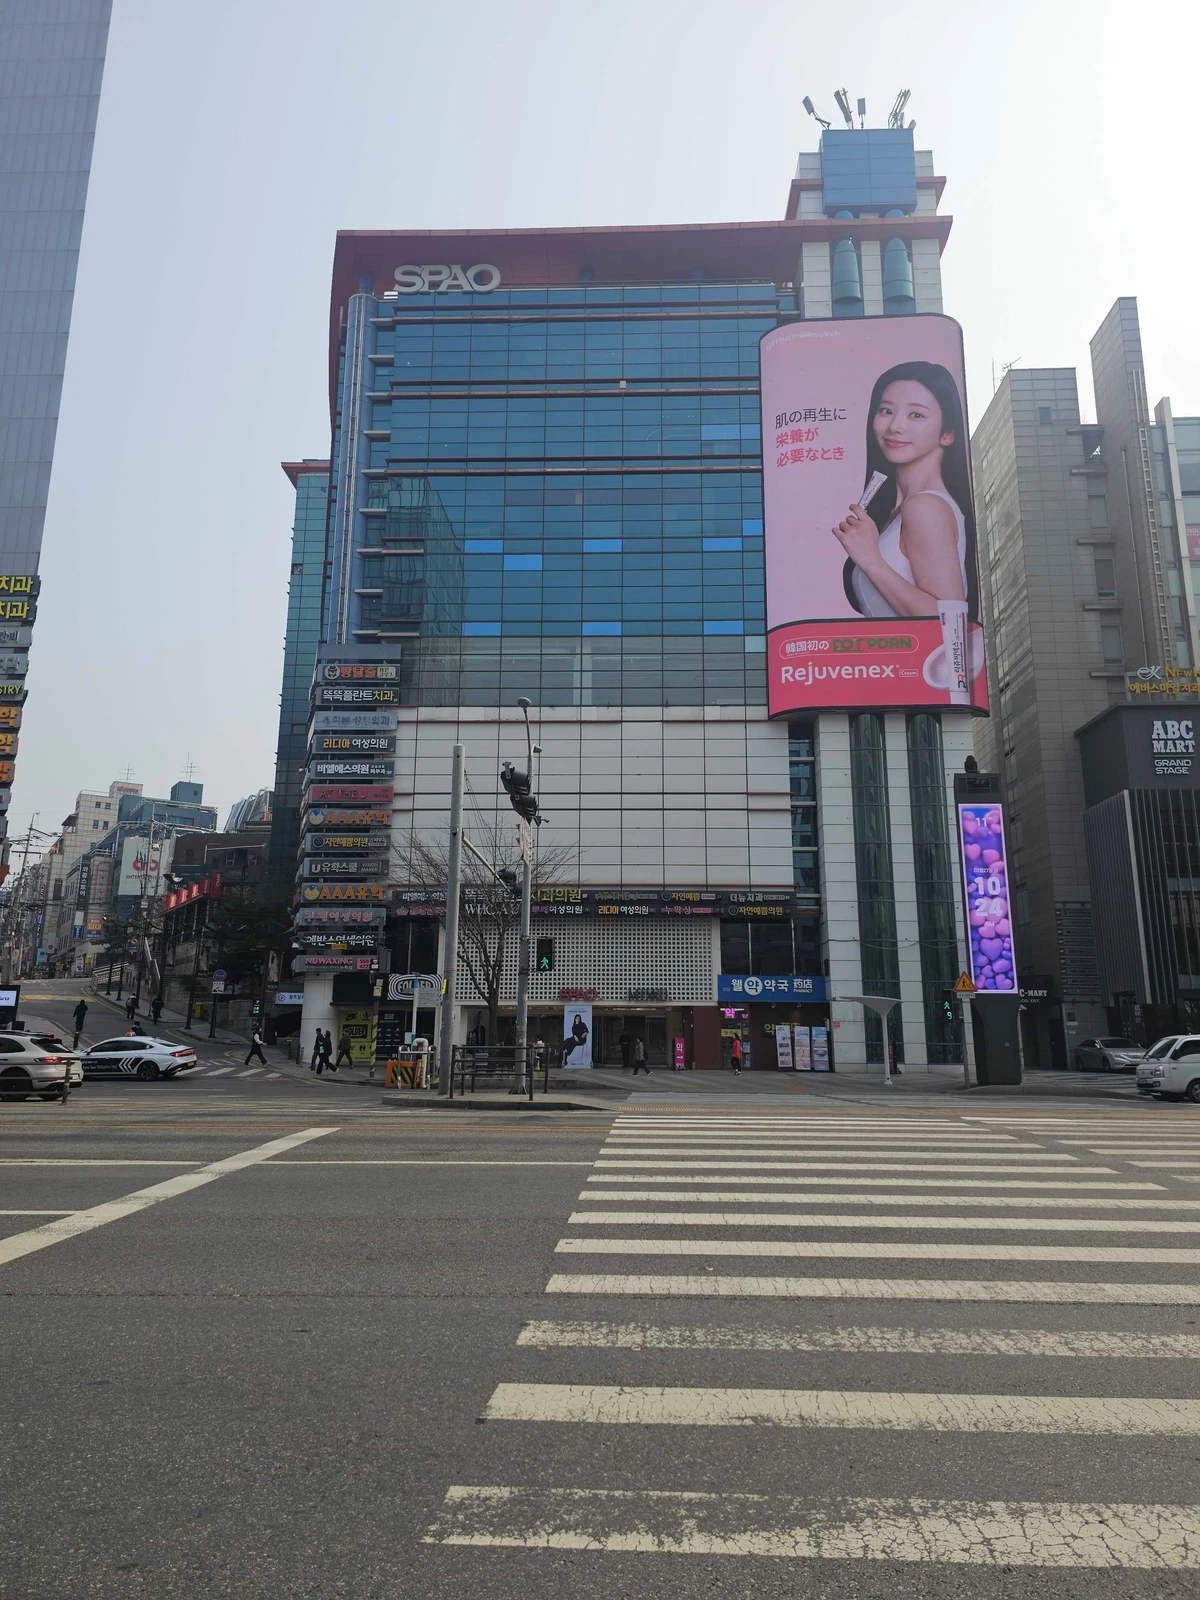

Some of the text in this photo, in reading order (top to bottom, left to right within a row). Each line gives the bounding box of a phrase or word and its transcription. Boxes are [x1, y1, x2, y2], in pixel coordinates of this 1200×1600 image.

[393, 263, 501, 295] SPAO
[774, 407, 847, 430] 肌の再生に
[775, 427, 819, 449] 栄養が
[776, 447, 845, 468] 必要なとき
[785, 640, 830, 654] 韓国初の
[867, 637, 912, 649] PDRN
[781, 662, 895, 686] Rejuvenex
[1151, 720, 1194, 740] ABC
[323, 738, 388, 749] 리디아 여성의원
[1152, 740, 1196, 753] MART
[317, 764, 369, 774] 비엘에스의원
[1154, 759, 1192, 767] GRAND
[1156, 767, 1190, 775] STAGE
[321, 862, 358, 873] 유학스쿨
[974, 876, 1001, 896] 10
[730, 893, 763, 902] 더뉴치과
[598, 905, 649, 915] 리디아 여성의원
[975, 898, 1003, 917] 24
[305, 957, 353, 965] NUWAXING
[558, 988, 598, 1001] SPAO
